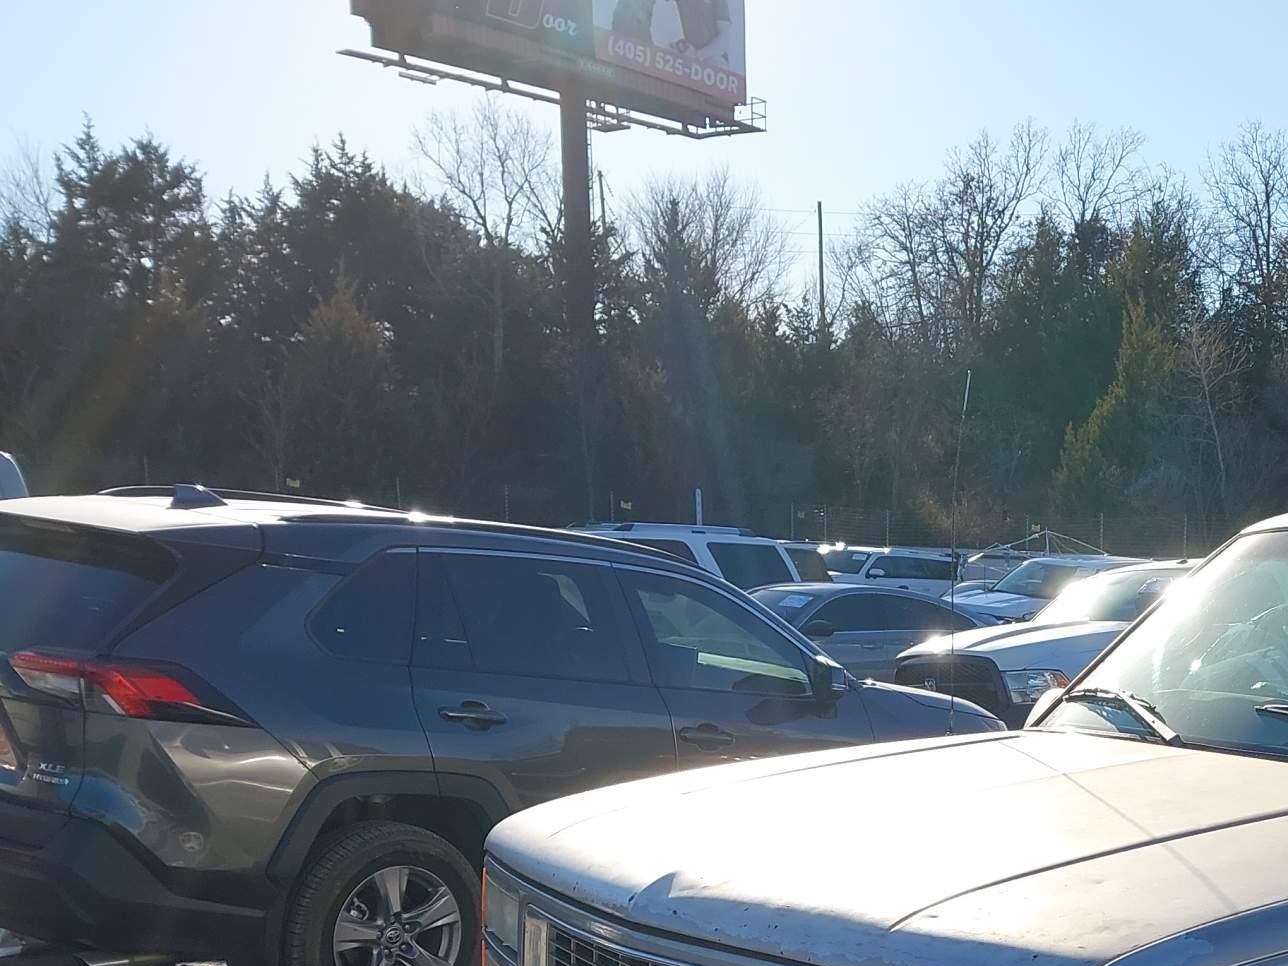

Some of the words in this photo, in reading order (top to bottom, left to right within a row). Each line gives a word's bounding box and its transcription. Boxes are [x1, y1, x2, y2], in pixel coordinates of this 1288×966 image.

[608, 35, 650, 66] (405)
[655, 52, 738, 94] 525-DOOR
[38, 762, 65, 773] XLE
